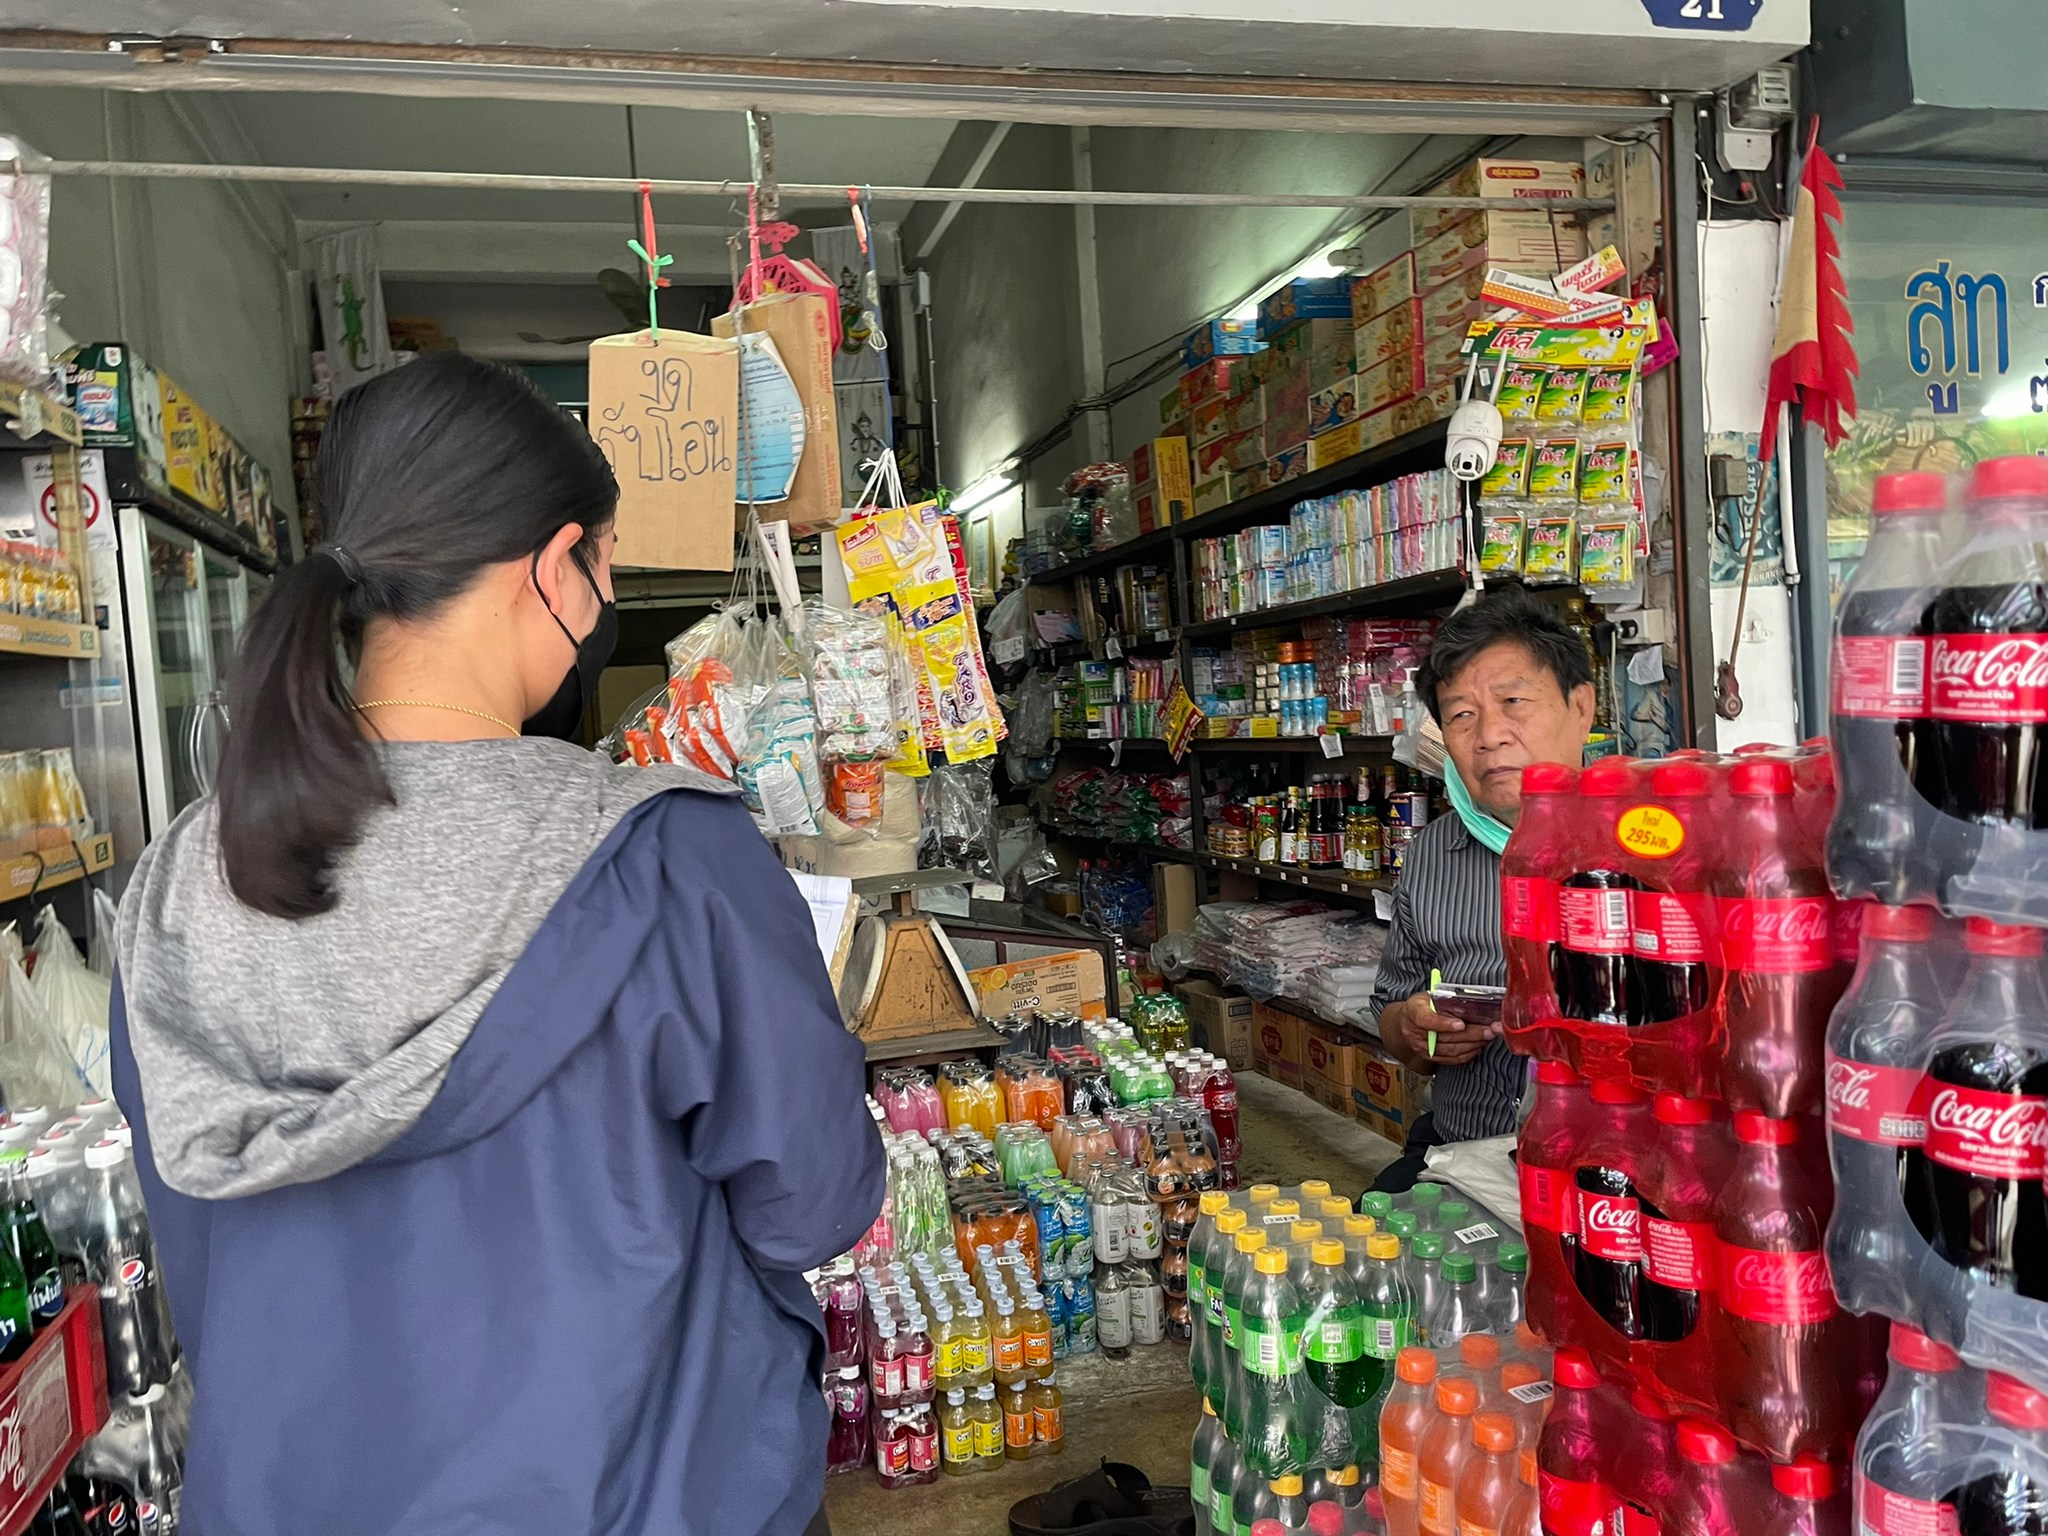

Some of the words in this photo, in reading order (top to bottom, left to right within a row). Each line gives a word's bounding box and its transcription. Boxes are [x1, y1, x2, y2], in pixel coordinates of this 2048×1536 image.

[1680, 0, 1724, 18] 21
[639, 357, 692, 412] งด
[1012, 996, 1041, 1010] C-vitt
[1931, 1089, 2048, 1147] Coca-Col
